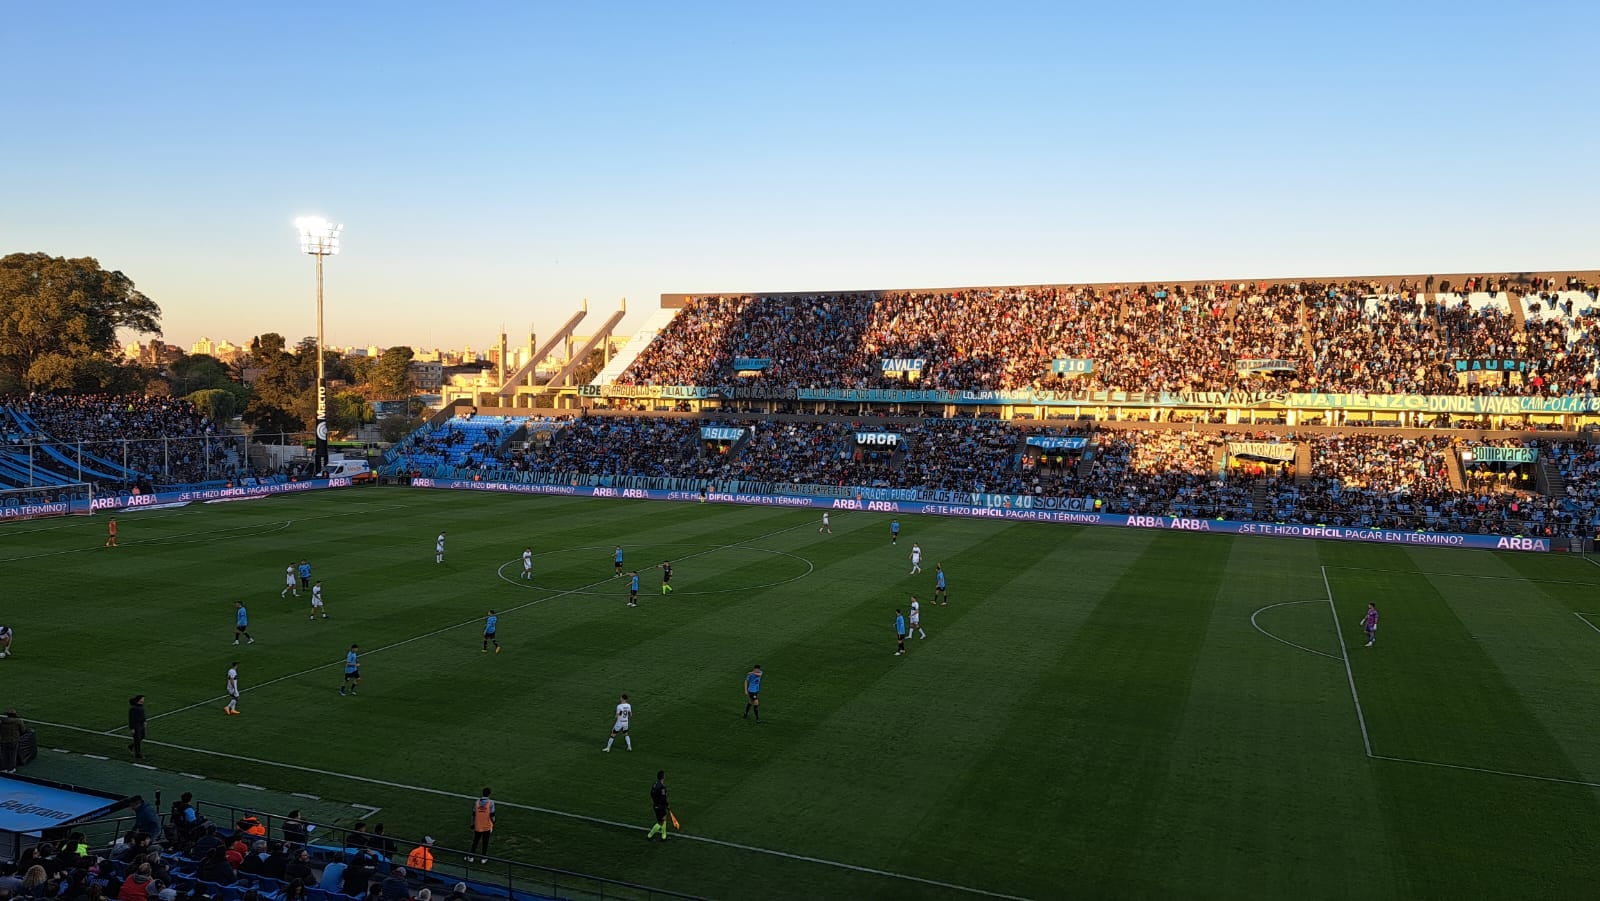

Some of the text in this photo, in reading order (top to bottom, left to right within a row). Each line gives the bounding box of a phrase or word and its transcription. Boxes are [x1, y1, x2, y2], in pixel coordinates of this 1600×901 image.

[578, 385, 601, 395] FEDE
[995, 391, 1000, 399] Y
[317, 386, 326, 420] Macro
[1292, 393, 1428, 407] MATIENZO
[1430, 395, 1519, 412] DONDE VAYAS
[857, 434, 897, 445] URCA
[328, 478, 351, 487] ARBA
[412, 478, 435, 487] ARBA
[486, 482, 508, 491] DIFÍCIL
[220, 486, 246, 496] DIFÍCIL
[592, 487, 618, 497] ARBA
[622, 488, 649, 498] ARBA
[892, 489, 916, 501] FUEGO
[917, 490, 950, 502] CARLOS
[91, 497, 122, 509] ARBA
[127, 494, 158, 506] ARBA
[709, 492, 734, 502] DIFÍCIL
[736, 494, 761, 503] PAGAR
[762, 496, 773, 504] EN
[1015, 495, 1032, 508] 40
[6, 508, 18, 516] EN
[22, 503, 67, 515] TÉRMINO?
[832, 499, 862, 510] ARBA
[868, 501, 899, 512] ARBA
[950, 507, 971, 515] HIZO
[972, 506, 1004, 517] DIFÍCIL
[1005, 510, 1036, 518] PAGAR
[1038, 511, 1051, 519] EN
[1053, 510, 1100, 522] TÉRMINO?
[1126, 515, 1165, 527] ARBA
[1171, 518, 1210, 530] ARBA
[1238, 524, 1464, 545] ¿SE TE HIZO DIFÍCIL PAGAR EN TÉRMINO?
[1497, 537, 1545, 550] ARBA
